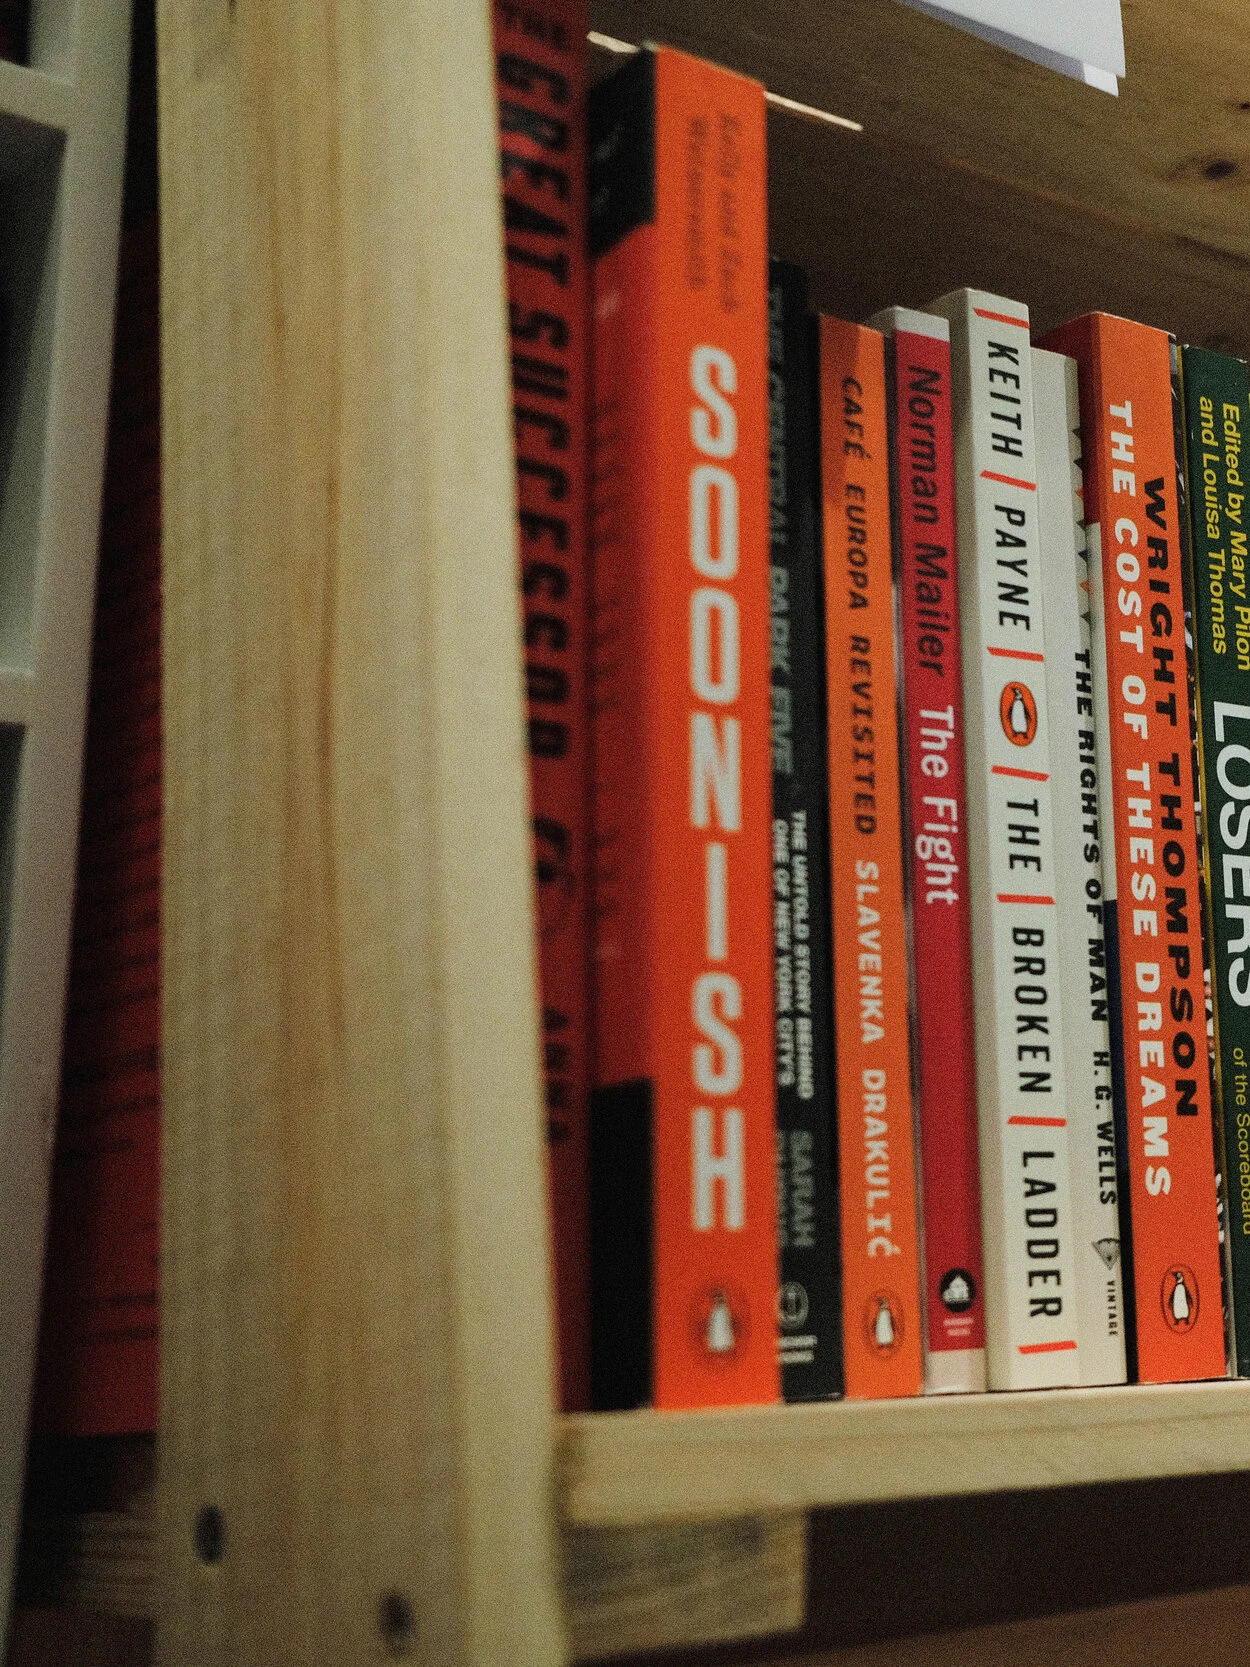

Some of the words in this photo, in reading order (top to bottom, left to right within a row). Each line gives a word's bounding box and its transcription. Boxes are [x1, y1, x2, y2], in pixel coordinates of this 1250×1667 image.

[500, 52, 571, 288] GREAT
[842, 375, 871, 461] CAFÉ
[988, 341, 1023, 458] KEITH
[1199, 397, 1218, 446] and
[907, 365, 942, 525] Norman
[1109, 400, 1136, 497] THE
[1222, 402, 1244, 489] Edited
[1203, 455, 1220, 540] Louisa
[1224, 493, 1246, 519] by
[845, 483, 869, 611] EUROPA
[994, 504, 1030, 632] PAYNE
[1114, 517, 1143, 654] COST
[1228, 524, 1250, 601] Mary
[915, 542, 949, 677] Mailer
[1144, 477, 1178, 727] WRIGHT
[1208, 550, 1227, 655] Thomas
[1074, 649, 1092, 717] THE
[1121, 675, 1149, 740] OF
[850, 634, 878, 836] REVISITED
[919, 706, 955, 778] The
[690, 344, 745, 1231] SOONISH
[791, 810, 807, 850] THE
[1077, 730, 1100, 863] RIGHTS
[773, 818, 789, 863] ONE
[915, 795, 960, 905] Fight
[1006, 799, 1041, 872] THE
[1126, 762, 1158, 937] THESE
[775, 868, 790, 897] OF
[792, 854, 810, 940] UNTOLD
[1085, 879, 1102, 925] OF
[855, 859, 885, 1044] SLAVENKA
[1158, 753, 1198, 1116] THOMPSON
[777, 954, 793, 1012] YORK
[794, 944, 812, 1013] STORY
[1012, 926, 1051, 1094] BROKEN
[1087, 938, 1108, 1022] MAN
[796, 1016, 814, 1100] BEHIND
[1135, 962, 1171, 1197] DREAMS
[1233, 1048, 1245, 1068] of
[1235, 1072, 1246, 1106] the
[862, 1069, 901, 1258] DRAKULIĆ
[1097, 1121, 1116, 1205] WELLS
[1022, 1150, 1063, 1319] LADDER
[1106, 1279, 1118, 1338] VINTAGE
